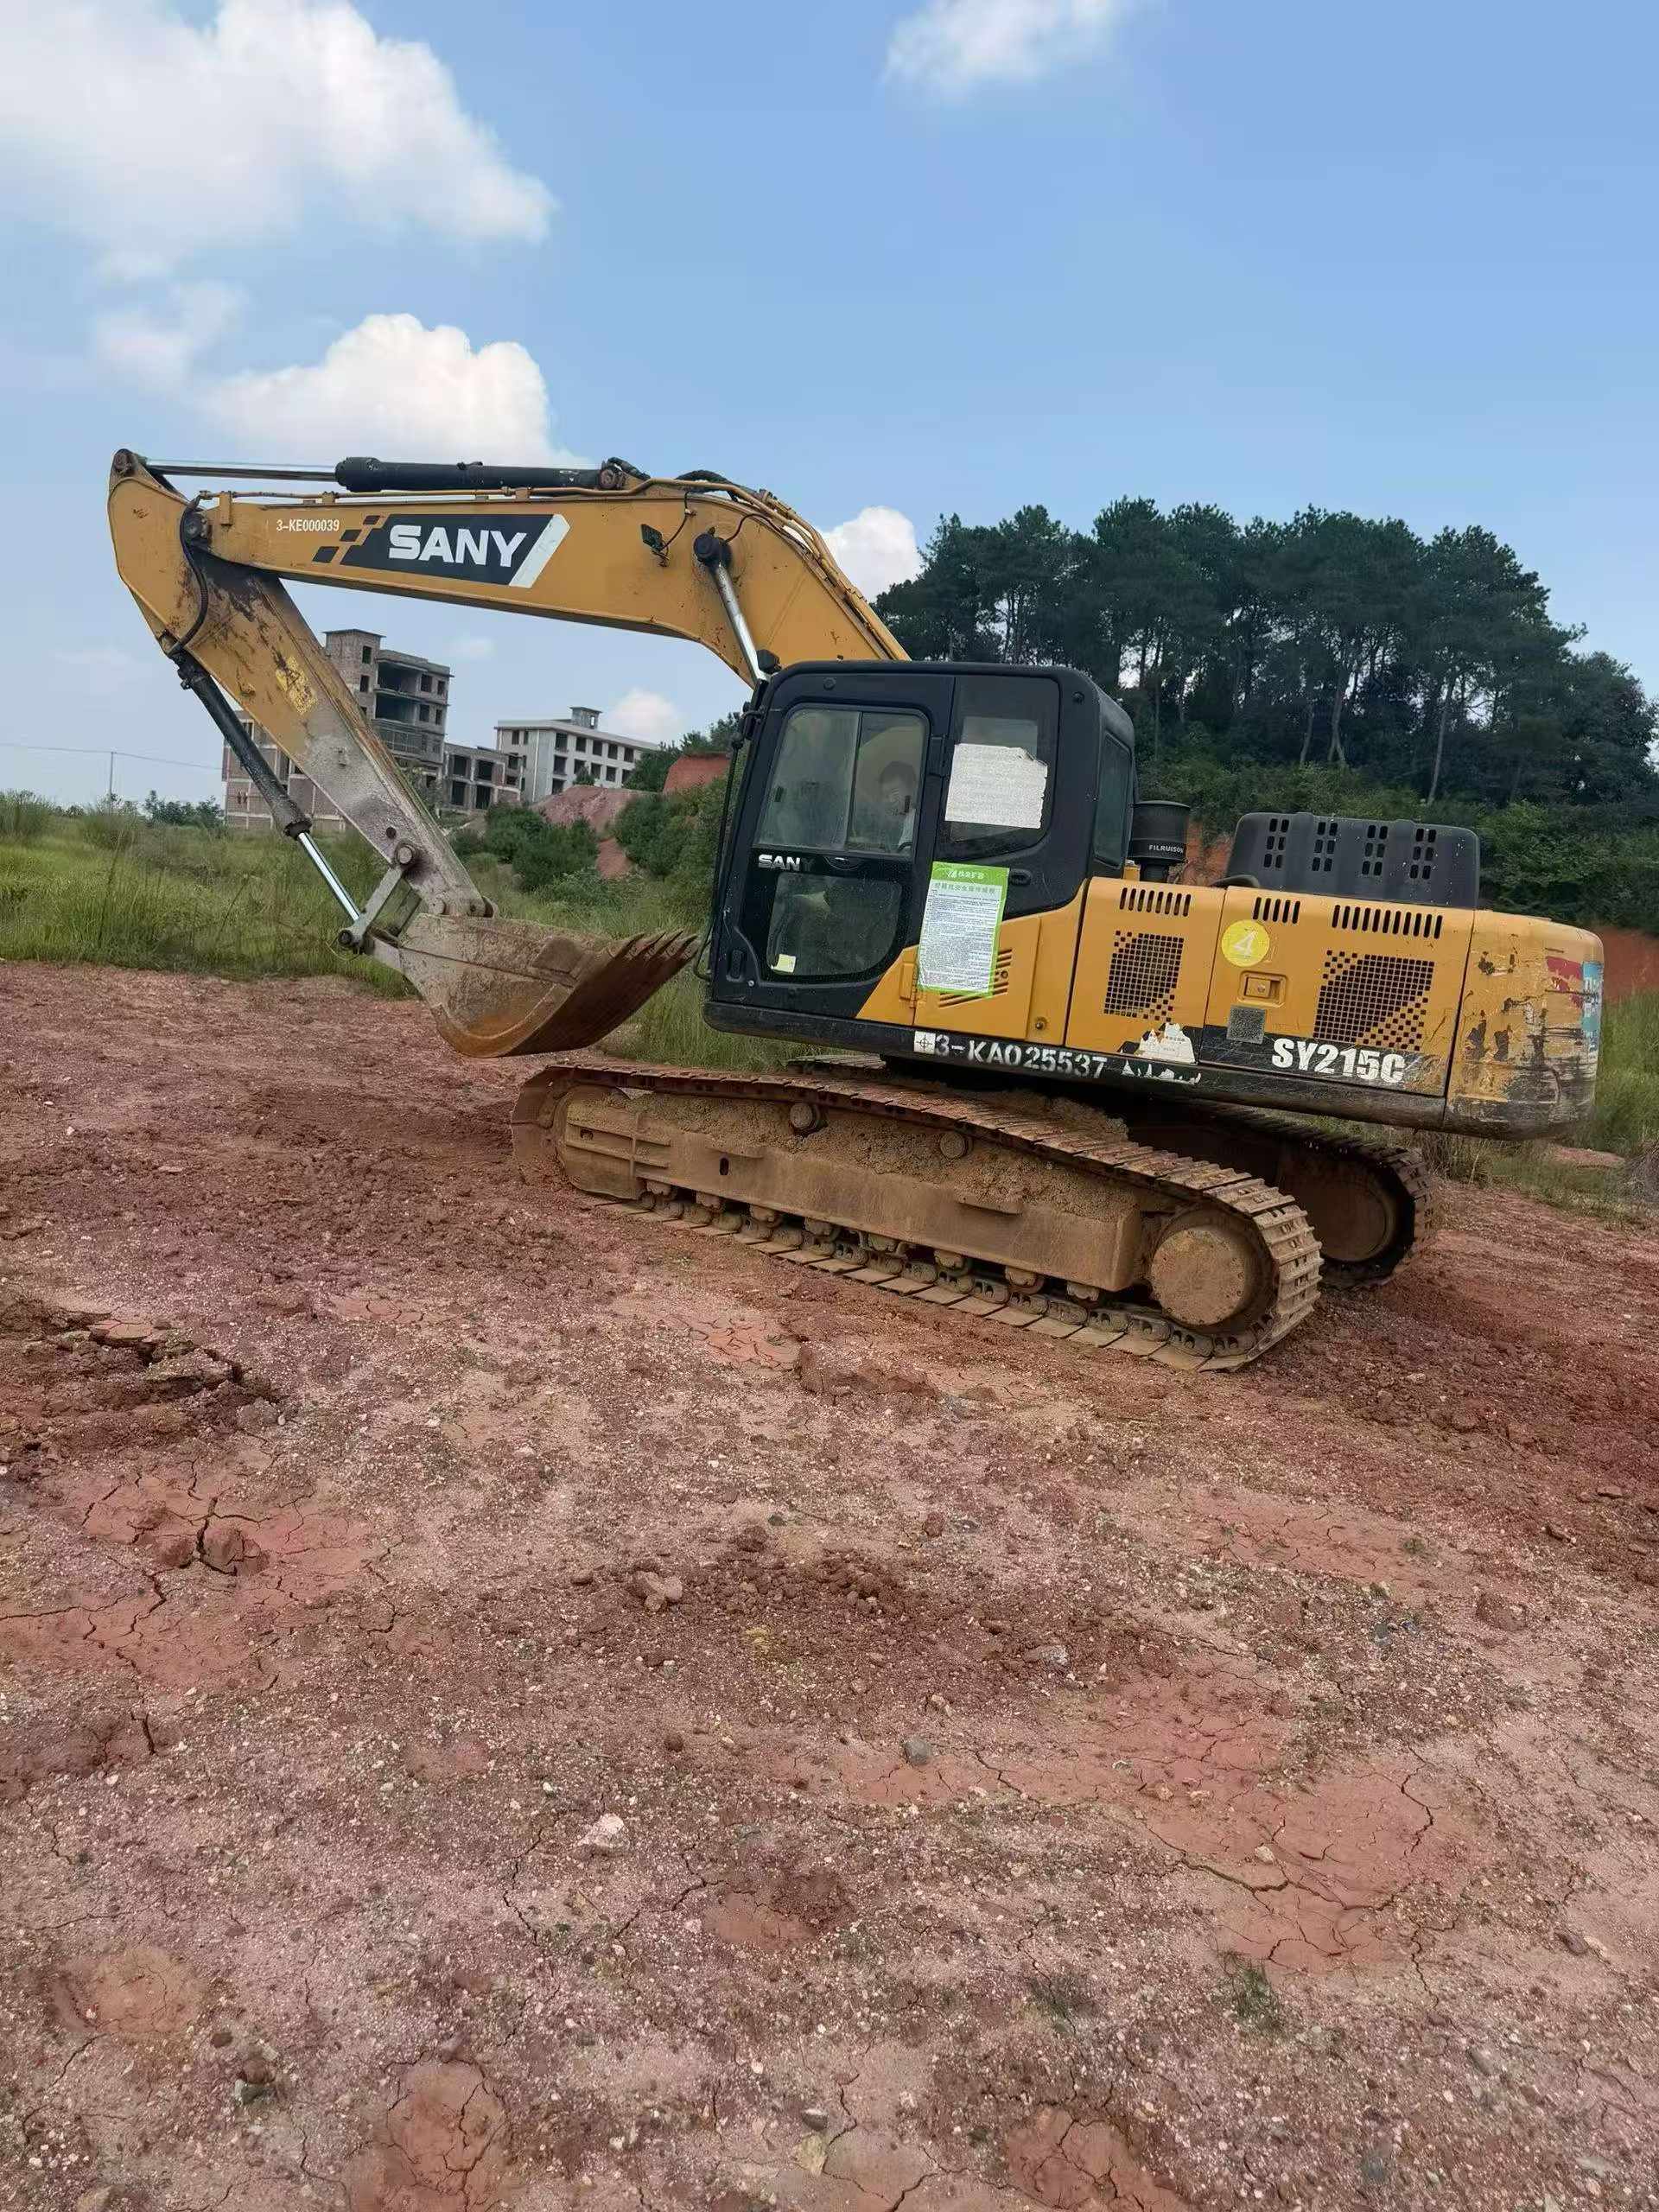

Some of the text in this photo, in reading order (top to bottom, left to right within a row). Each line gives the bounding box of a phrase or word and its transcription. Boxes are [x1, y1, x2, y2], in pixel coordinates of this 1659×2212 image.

[276, 518, 340, 532] 3-KE000039
[388, 524, 527, 568] SANY
[935, 1033, 1108, 1079] 3-KA025537
[1271, 1038, 1407, 1084] SY215C
